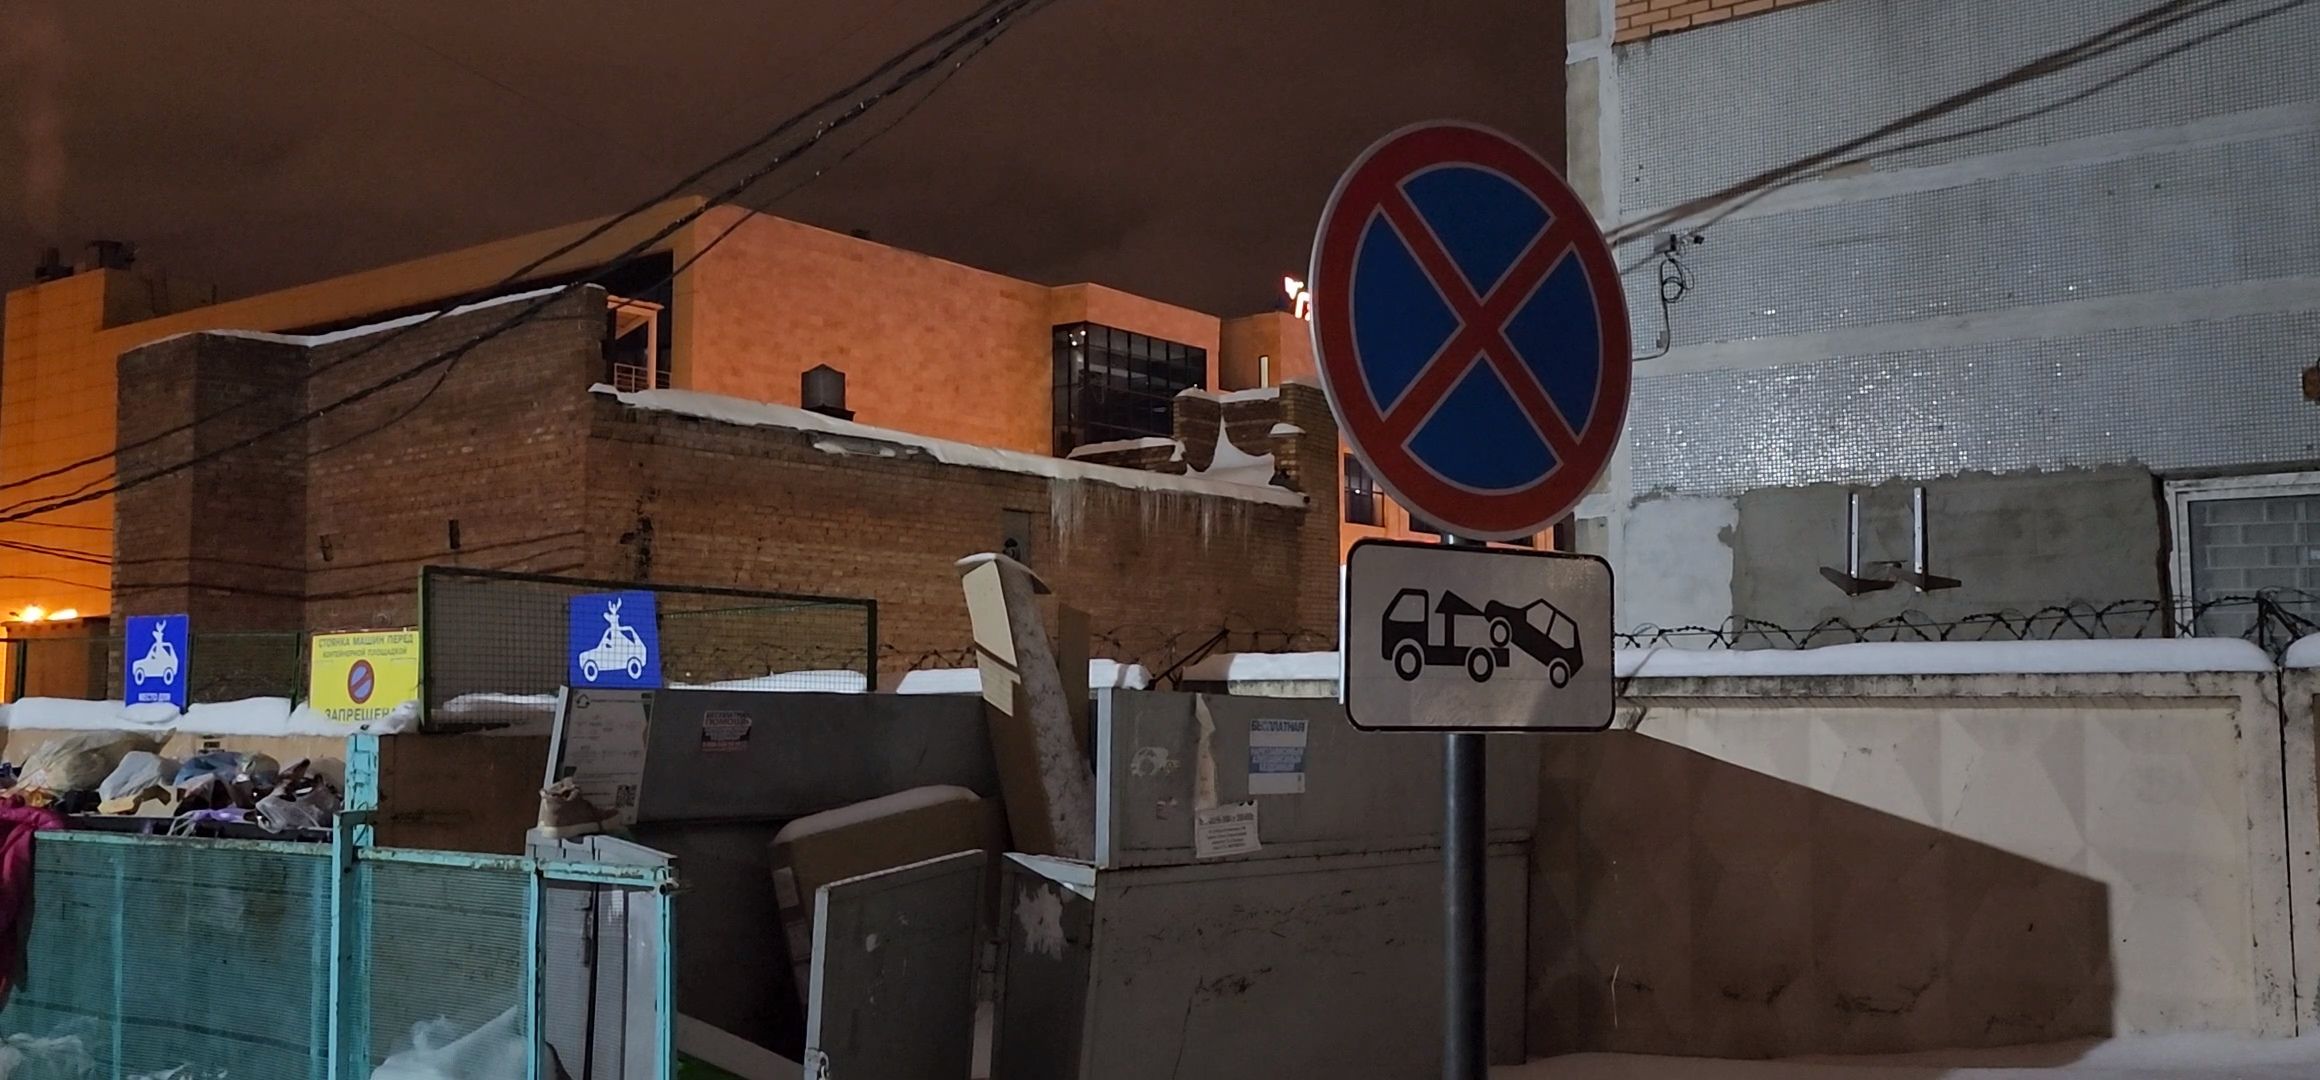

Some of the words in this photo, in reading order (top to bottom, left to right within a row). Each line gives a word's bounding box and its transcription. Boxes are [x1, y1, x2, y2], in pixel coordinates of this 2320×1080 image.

[319, 638, 350, 648] СТОЯНКА
[353, 636, 385, 646] МАШИН
[387, 634, 414, 644] ПЕРЕД
[1251, 720, 1305, 732] БЕСПЛАТНАЯ
